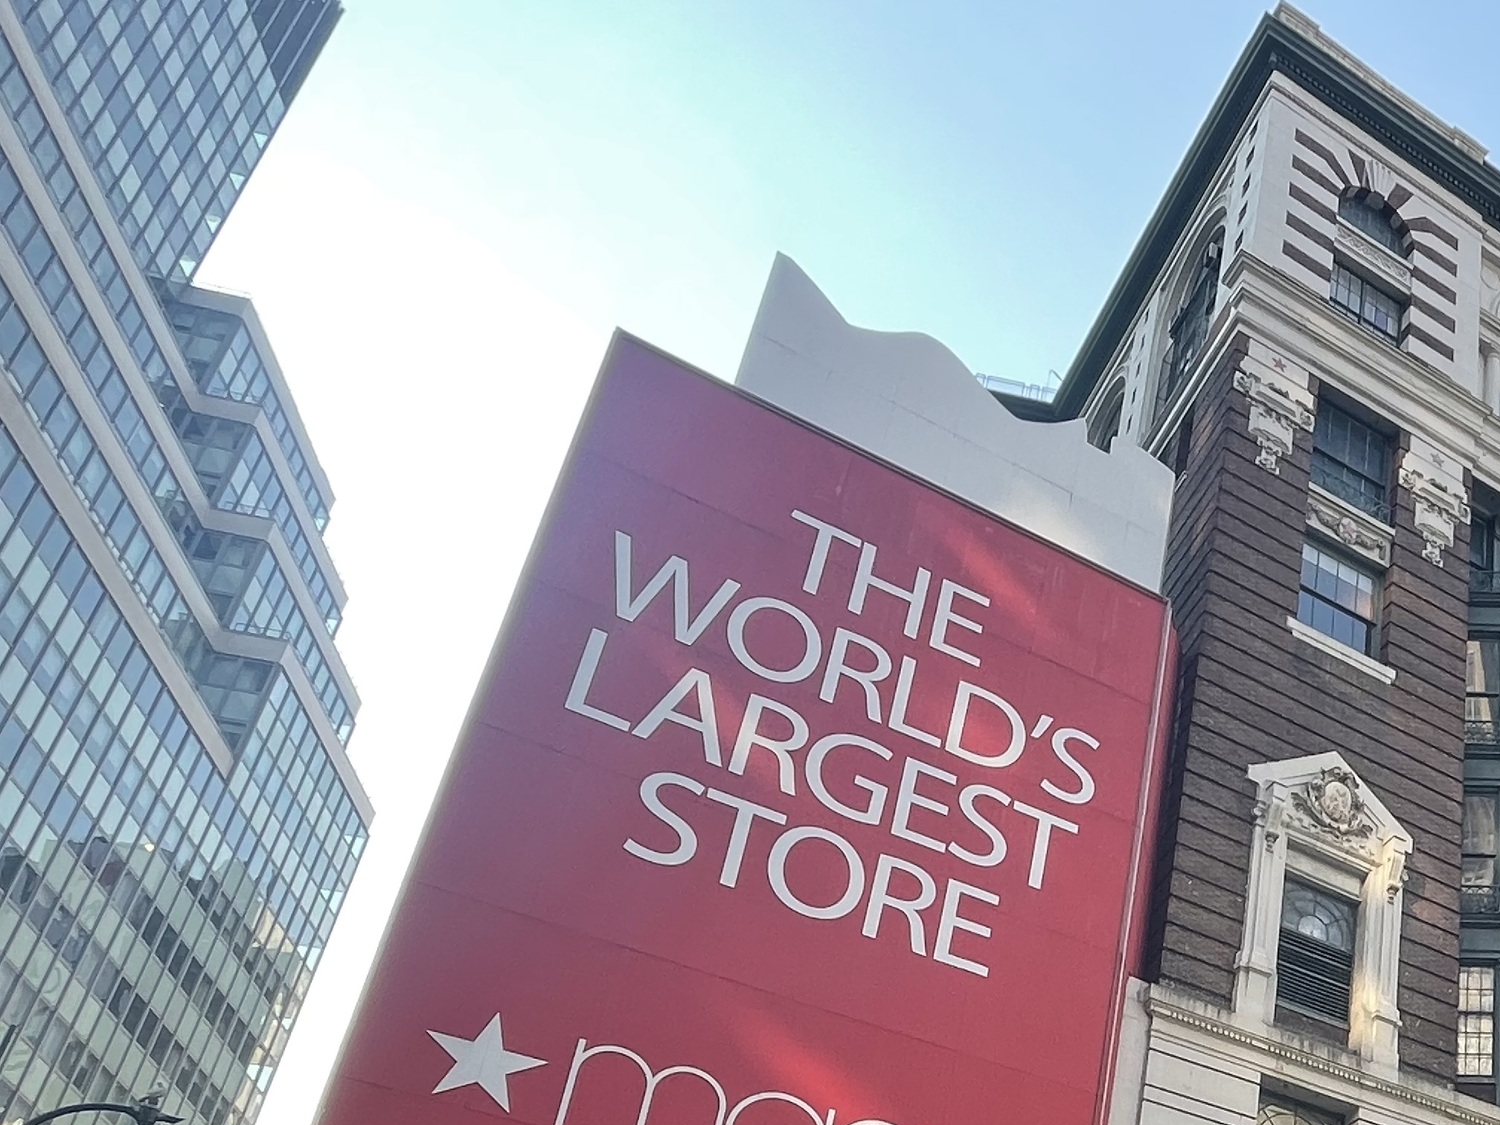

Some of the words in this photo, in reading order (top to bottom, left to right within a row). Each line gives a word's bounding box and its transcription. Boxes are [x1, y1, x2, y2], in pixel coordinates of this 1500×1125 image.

[612, 529, 1102, 806] WORLD'S
[789, 508, 992, 669] THE
[563, 627, 1081, 891] LARGEST
[621, 769, 1001, 978] STORE
